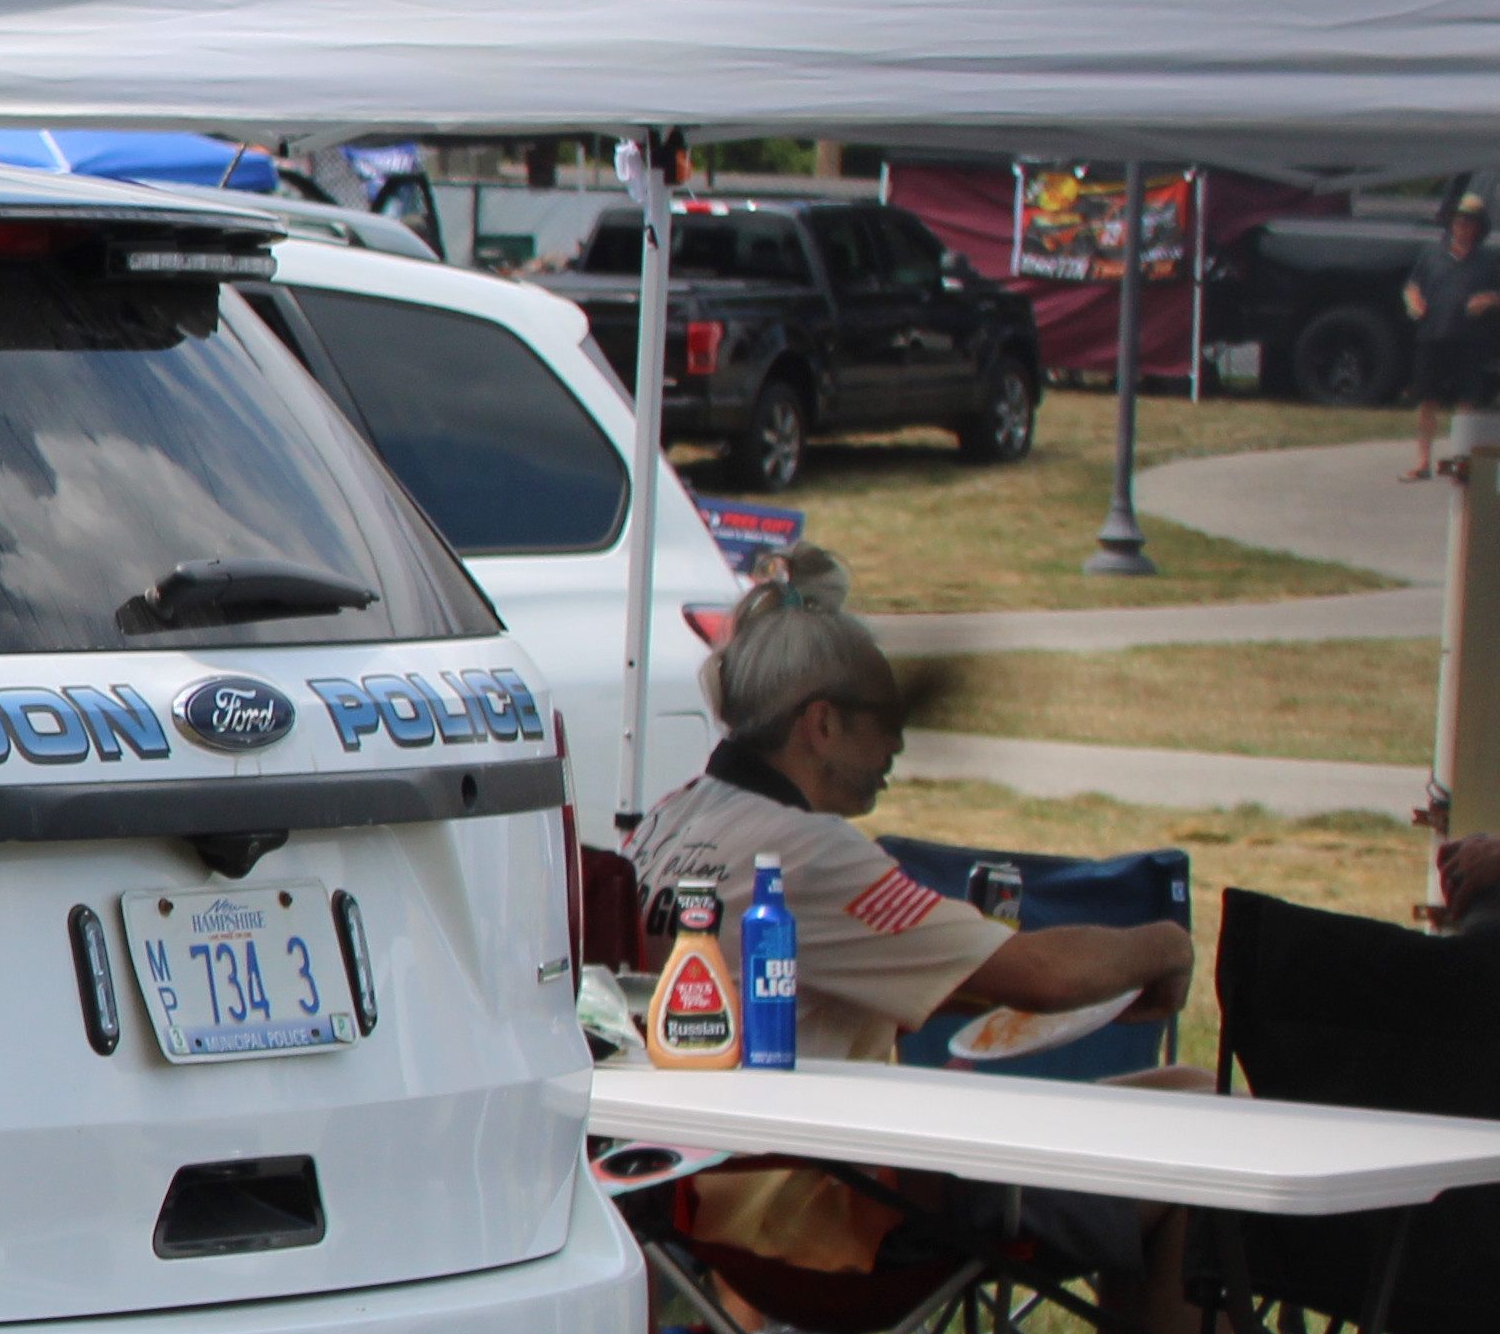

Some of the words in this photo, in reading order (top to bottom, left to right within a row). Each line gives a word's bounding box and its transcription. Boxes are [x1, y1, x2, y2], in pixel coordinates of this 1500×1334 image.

[211, 686, 275, 734] Ford
[306, 668, 545, 753] POLICE
[204, 898, 249, 915] New
[191, 910, 267, 934] HAMPSHIRE
[190, 940, 271, 1025] 734
[286, 936, 320, 1015] 3
[206, 1031, 265, 1053] MUNICIPAL
[267, 1028, 309, 1049] POLICE
[668, 1021, 726, 1037] Russian
